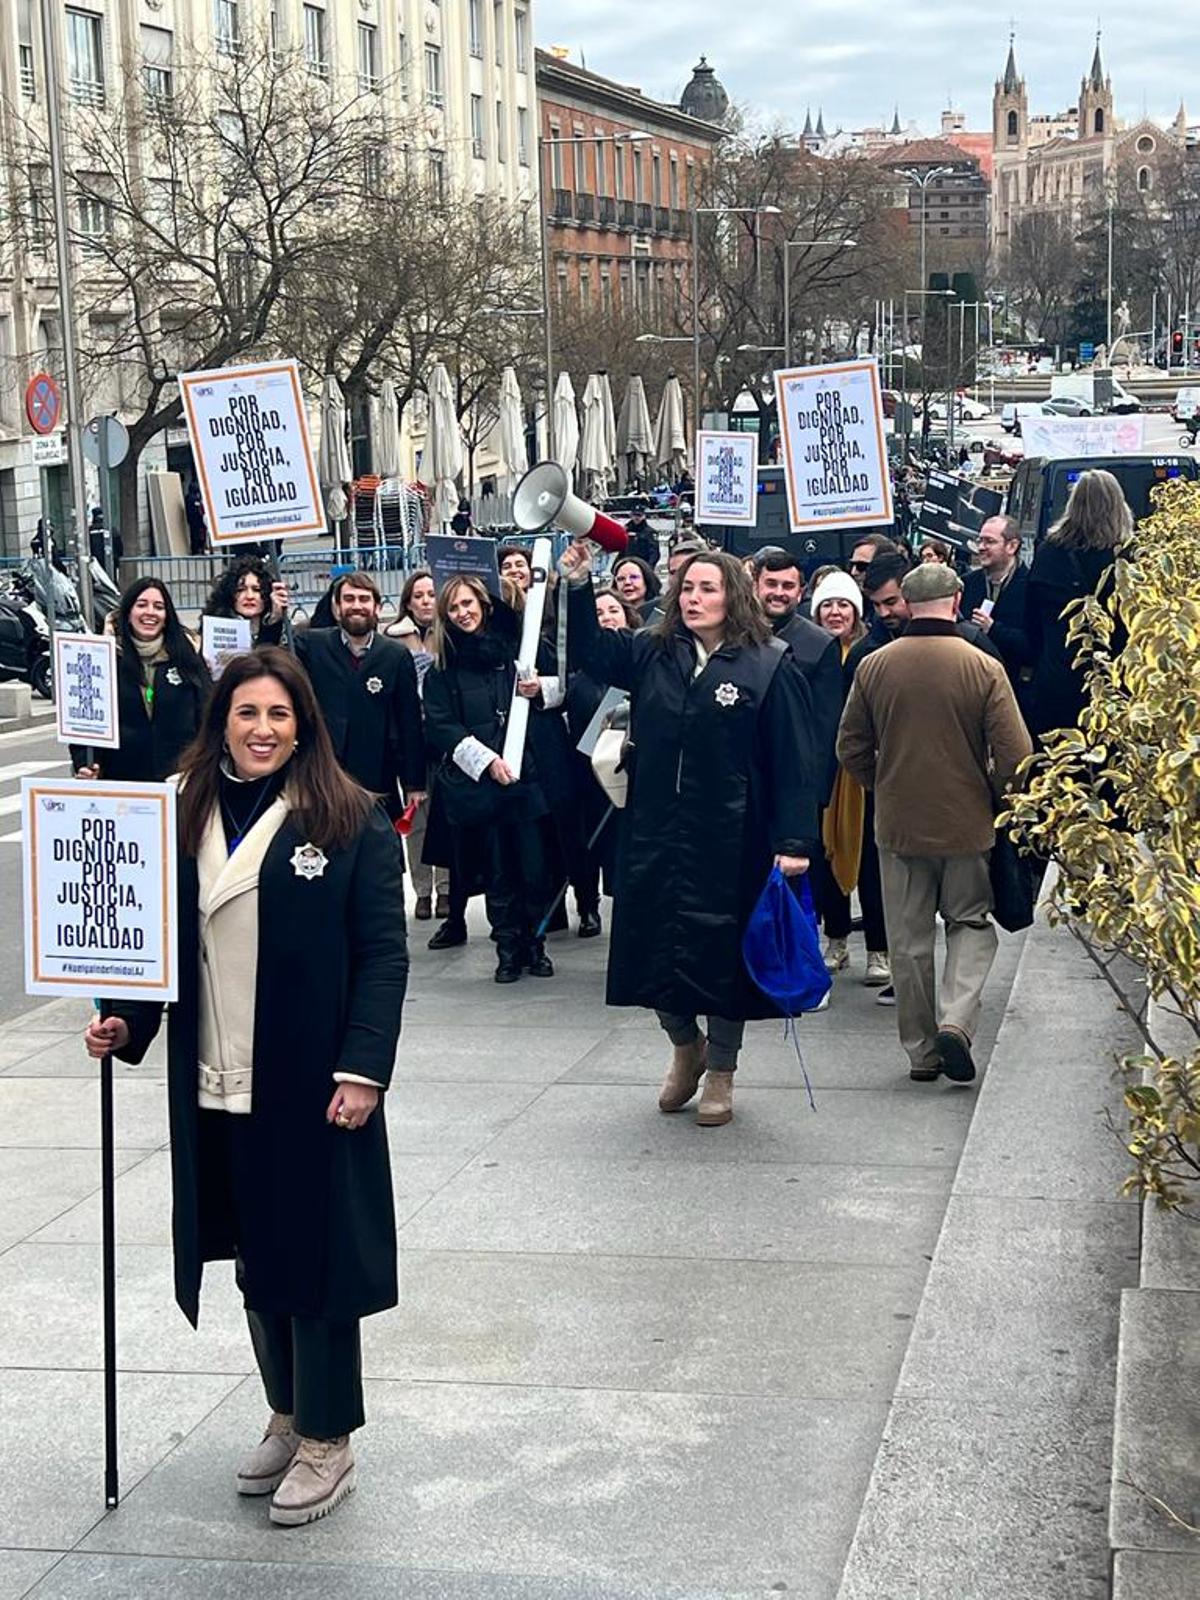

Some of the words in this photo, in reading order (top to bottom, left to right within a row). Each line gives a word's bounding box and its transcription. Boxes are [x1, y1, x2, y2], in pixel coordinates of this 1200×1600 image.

[228, 394, 259, 416] POR
[816, 391, 841, 411] POR
[209, 410, 287, 437] DIGNIDAD,
[798, 406, 864, 430] DIGNIDAD,
[236, 430, 267, 453] POR
[819, 425, 845, 447] POR
[220, 446, 291, 473] JUSTICIA,
[804, 440, 865, 463] JUSTICIA,
[242, 465, 273, 491] POR
[822, 458, 849, 478] POR
[225, 481, 297, 508] IGUALDAD
[806, 474, 869, 497] IGUALDAD
[82, 818, 116, 842] POR
[54, 838, 145, 868] DIGNIDAD,
[82, 861, 116, 885] POR
[57, 881, 142, 911] JUSTICIA,
[83, 903, 117, 928] POR
[57, 924, 144, 950] IGUALDAD
